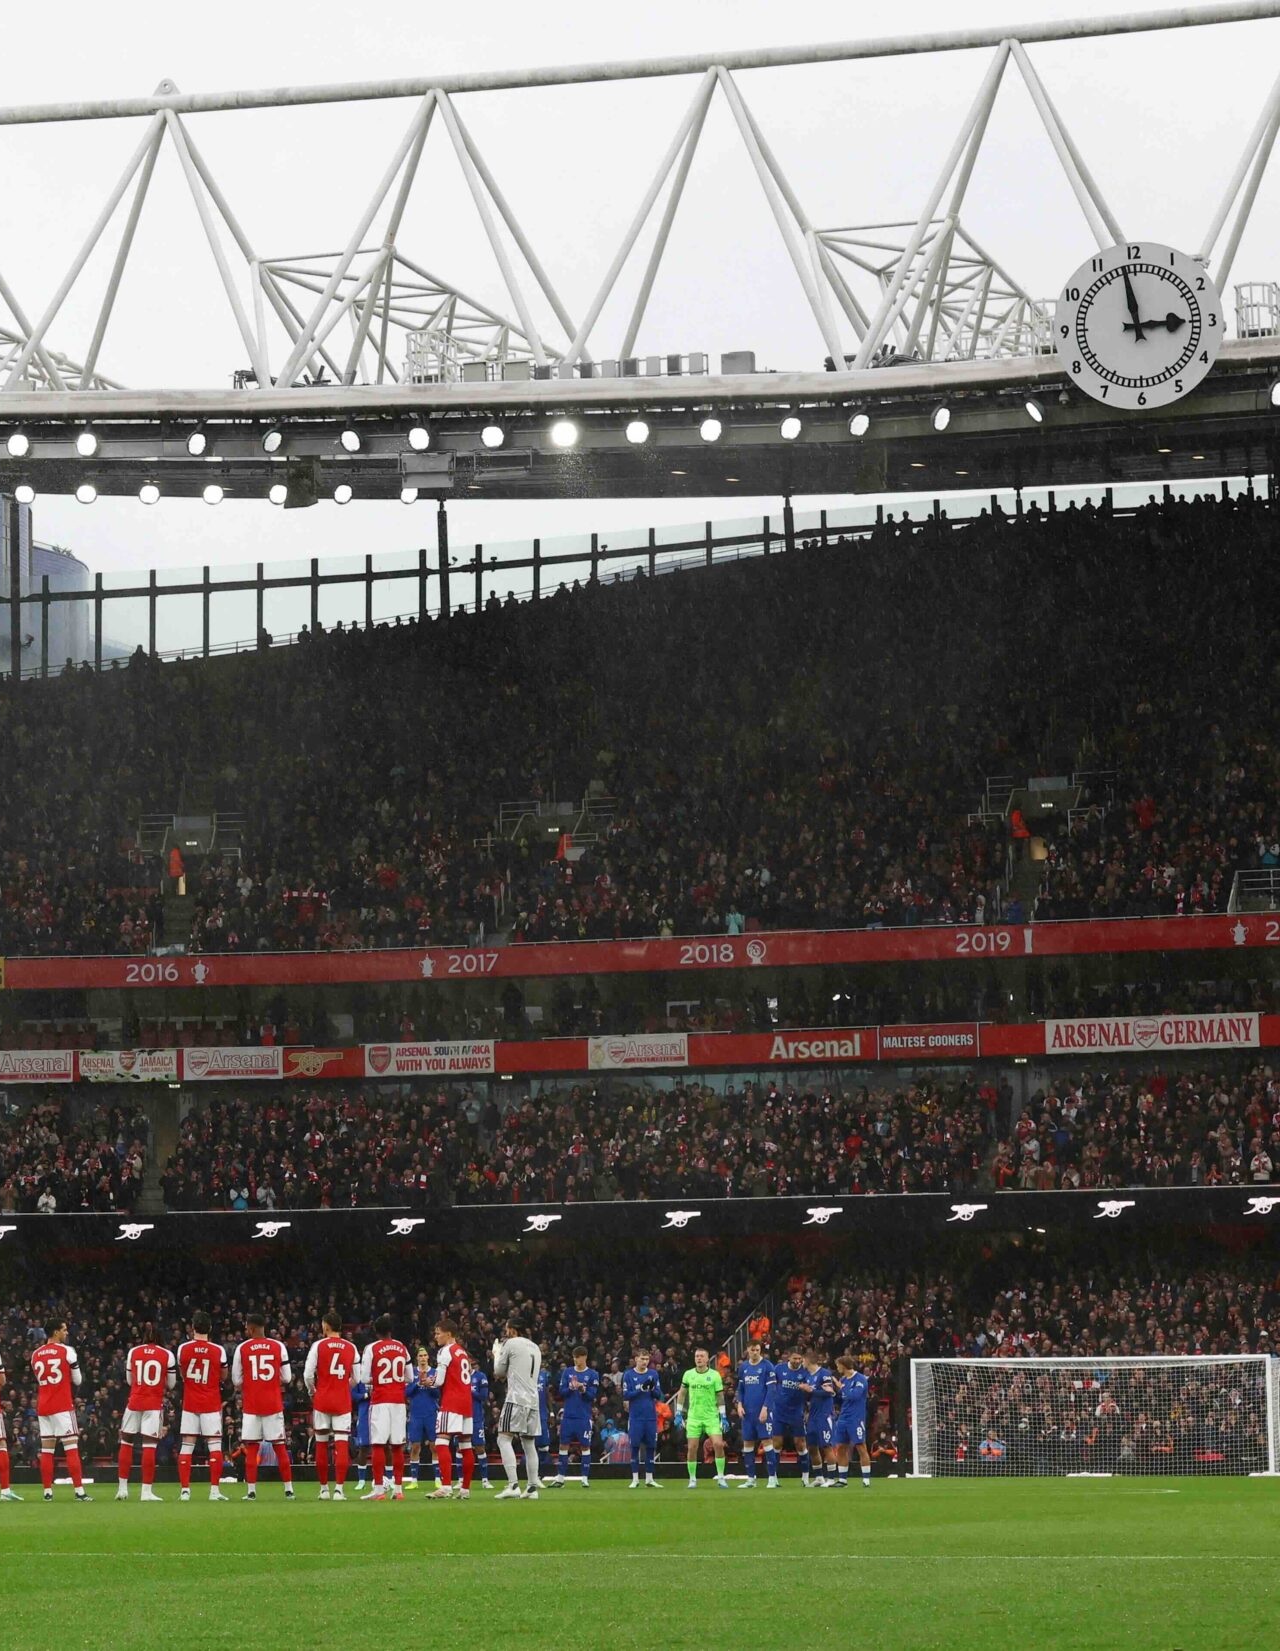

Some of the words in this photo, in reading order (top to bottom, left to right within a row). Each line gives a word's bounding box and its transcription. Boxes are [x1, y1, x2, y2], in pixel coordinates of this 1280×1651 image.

[1127, 246, 1141, 260] 12
[1170, 252, 1175, 266] 1
[1092, 258, 1103, 272] 11
[1195, 277, 1206, 291] 2
[1065, 288, 1080, 302] 10
[1208, 313, 1217, 327] 3
[1060, 325, 1070, 338] 9
[1199, 350, 1209, 364] 4
[1072, 360, 1082, 374] 8
[1100, 385, 1109, 398] 7
[1174, 379, 1183, 393] 5
[1137, 392, 1147, 405] 6
[955, 931, 1011, 953] 2019
[679, 943, 734, 964] 2018
[448, 953, 499, 974] 2017
[125, 963, 179, 983] 2016
[1051, 1022, 1134, 1048] ARSENAL
[1160, 1017, 1253, 1045] GERMANY
[625, 1038, 685, 1057] Arsenal
[770, 1033, 860, 1060] Arsenal
[882, 1036, 926, 1049] MALTESE
[928, 1034, 974, 1047] GOONERS
[395, 1046, 432, 1057] ARSENAL
[434, 1046, 460, 1056] SOUTH
[461, 1044, 490, 1056] AFRICA
[0, 1052, 72, 1073] Arsenal
[81, 1057, 115, 1069] ARSENAL
[139, 1056, 174, 1068] JAMAICA
[210, 1049, 279, 1069] Arsenal
[395, 1059, 423, 1072] WITH
[425, 1058, 446, 1071] YOU
[449, 1056, 491, 1070] ALWAYS
[327, 1342, 346, 1350] WHITE
[34, 1358, 63, 1386] 23
[135, 1359, 162, 1386] 10
[186, 1358, 210, 1385] 41
[248, 1354, 275, 1381] 15
[329, 1352, 346, 1380] 4
[377, 1356, 406, 1385] 20
[460, 1358, 471, 1385] 8
[531, 1353, 536, 1379] 1
[822, 1430, 832, 1440] 16
[856, 1426, 864, 1436] 8
